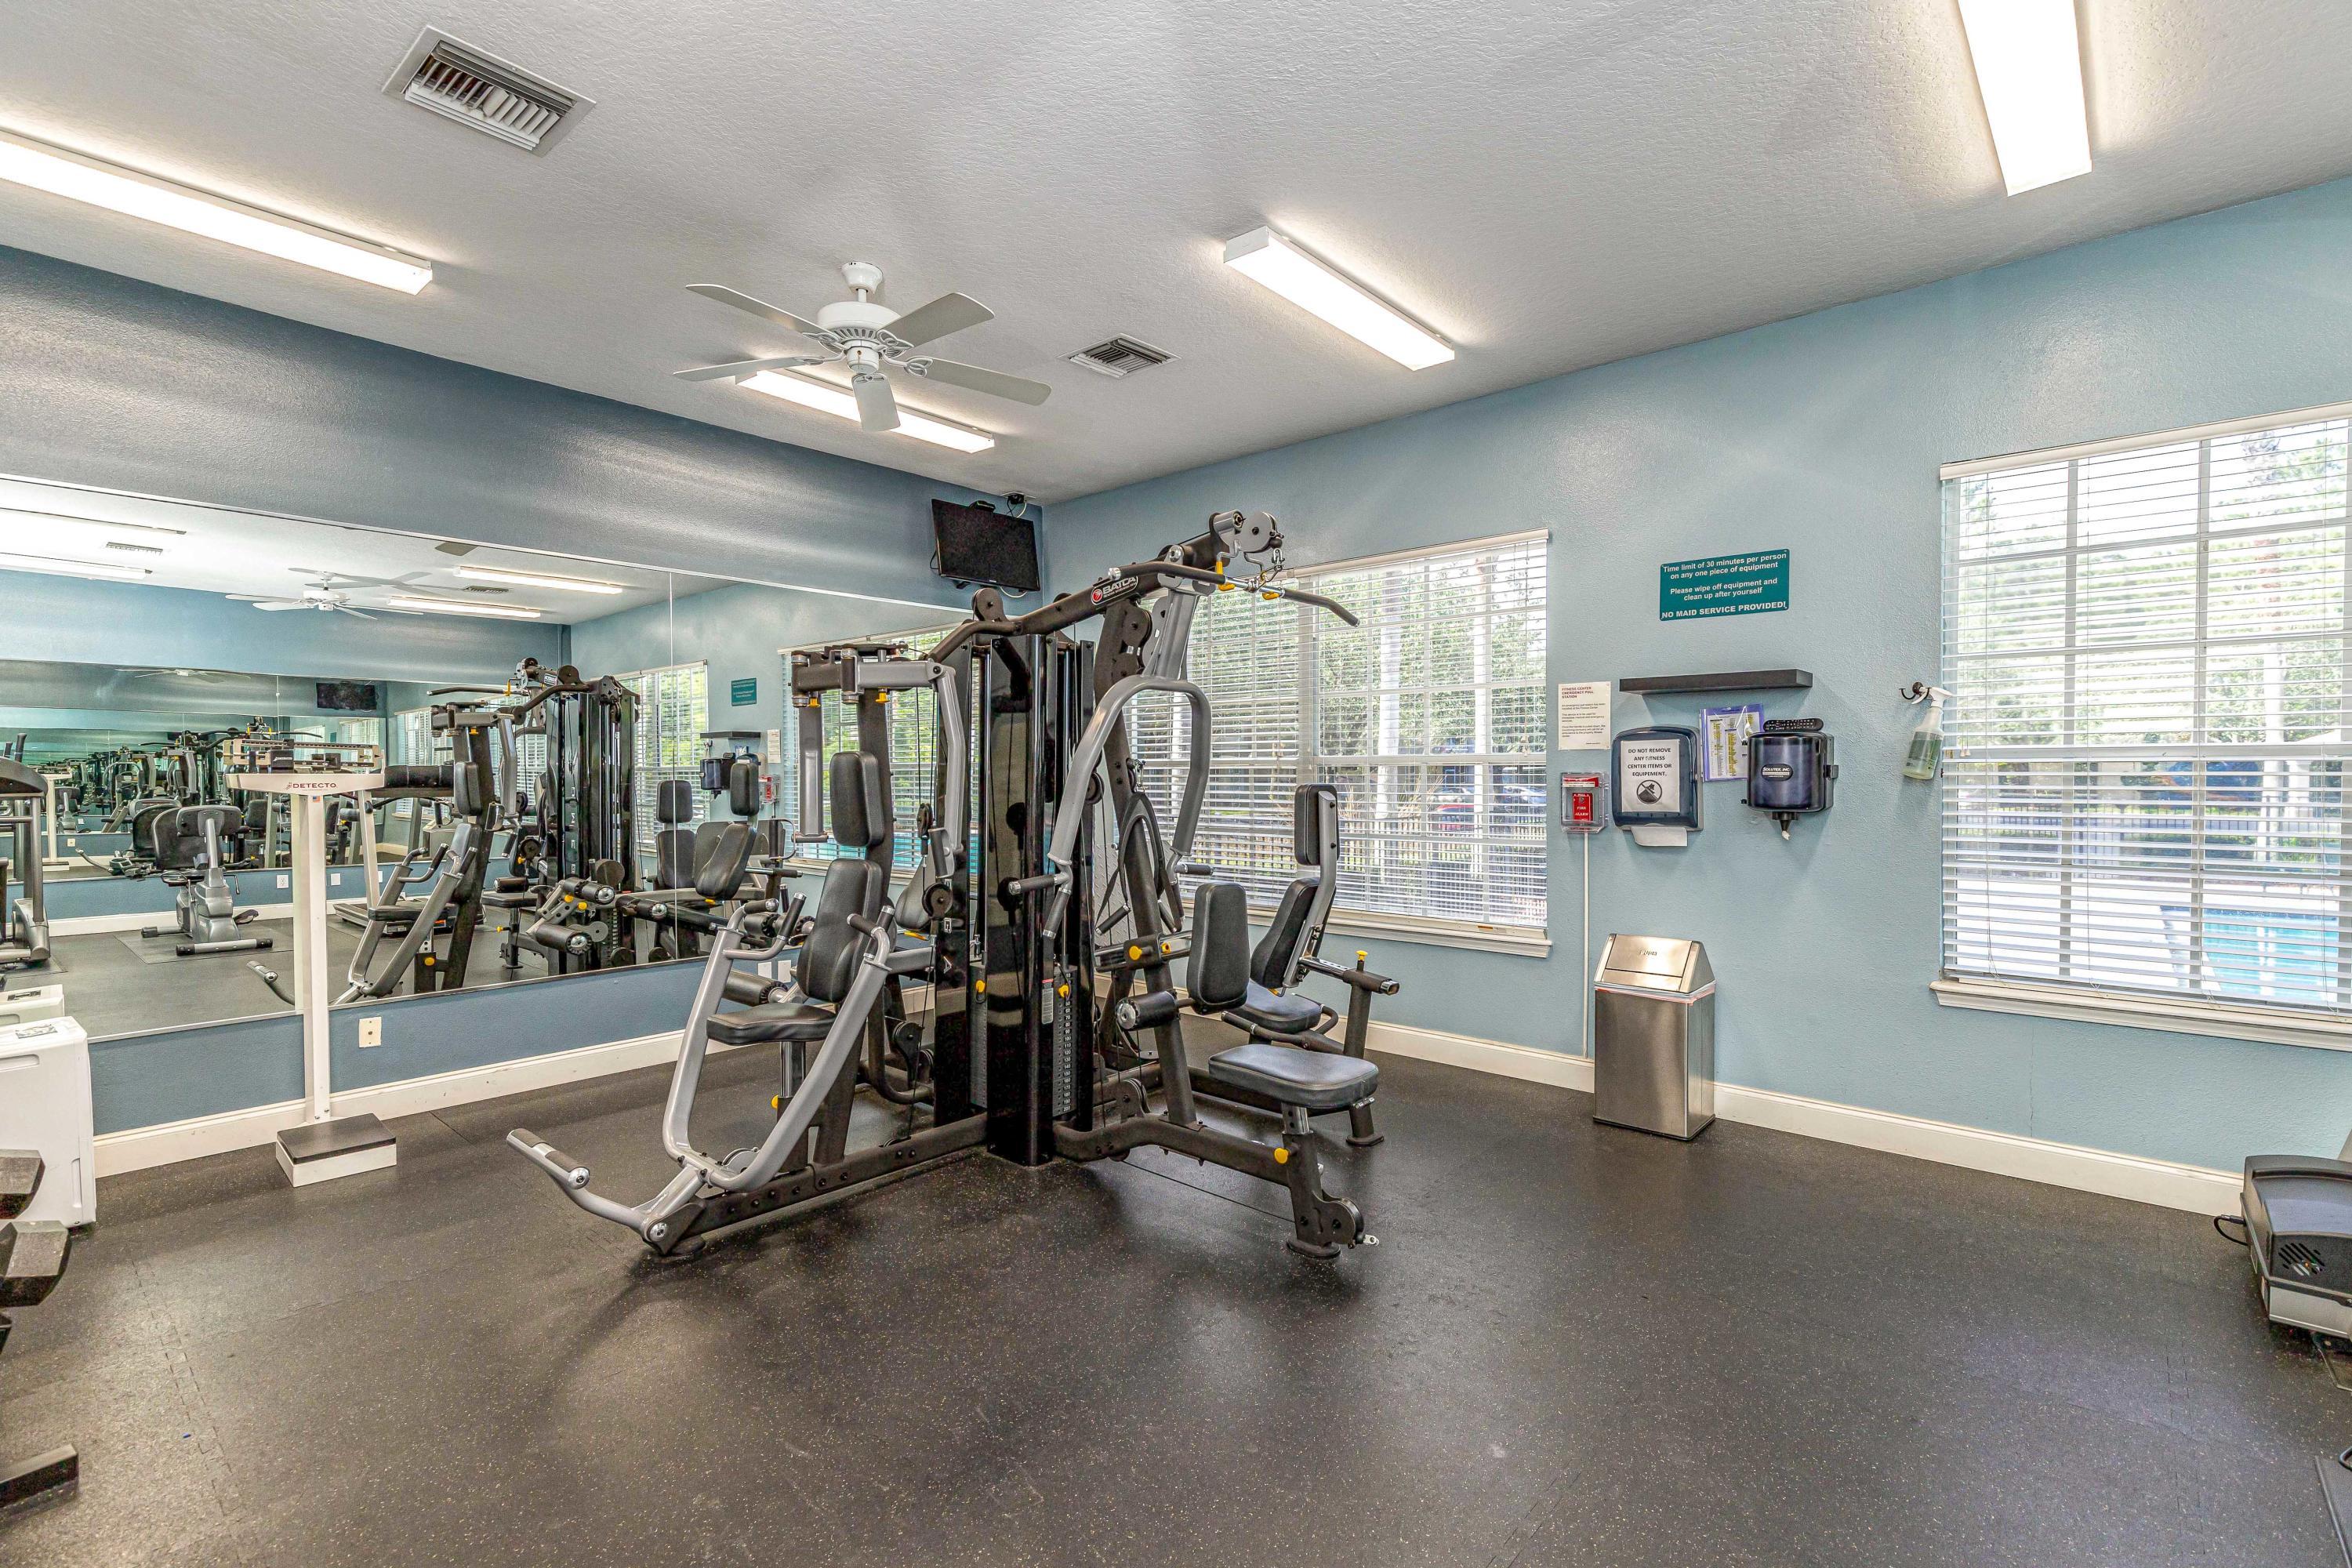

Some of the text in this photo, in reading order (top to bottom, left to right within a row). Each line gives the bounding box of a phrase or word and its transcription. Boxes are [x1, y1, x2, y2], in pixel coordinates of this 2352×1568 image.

[1760, 553, 1787, 562] person
[1681, 571, 1693, 579] any
[1739, 561, 1778, 572] equipment
[1102, 576, 1136, 594] BATCA
[1723, 580, 1762, 590] equipment
[1732, 587, 1763, 597] yourself
[1699, 605, 1736, 615] SERVICE
[1738, 601, 1786, 612] PROVIDED!
